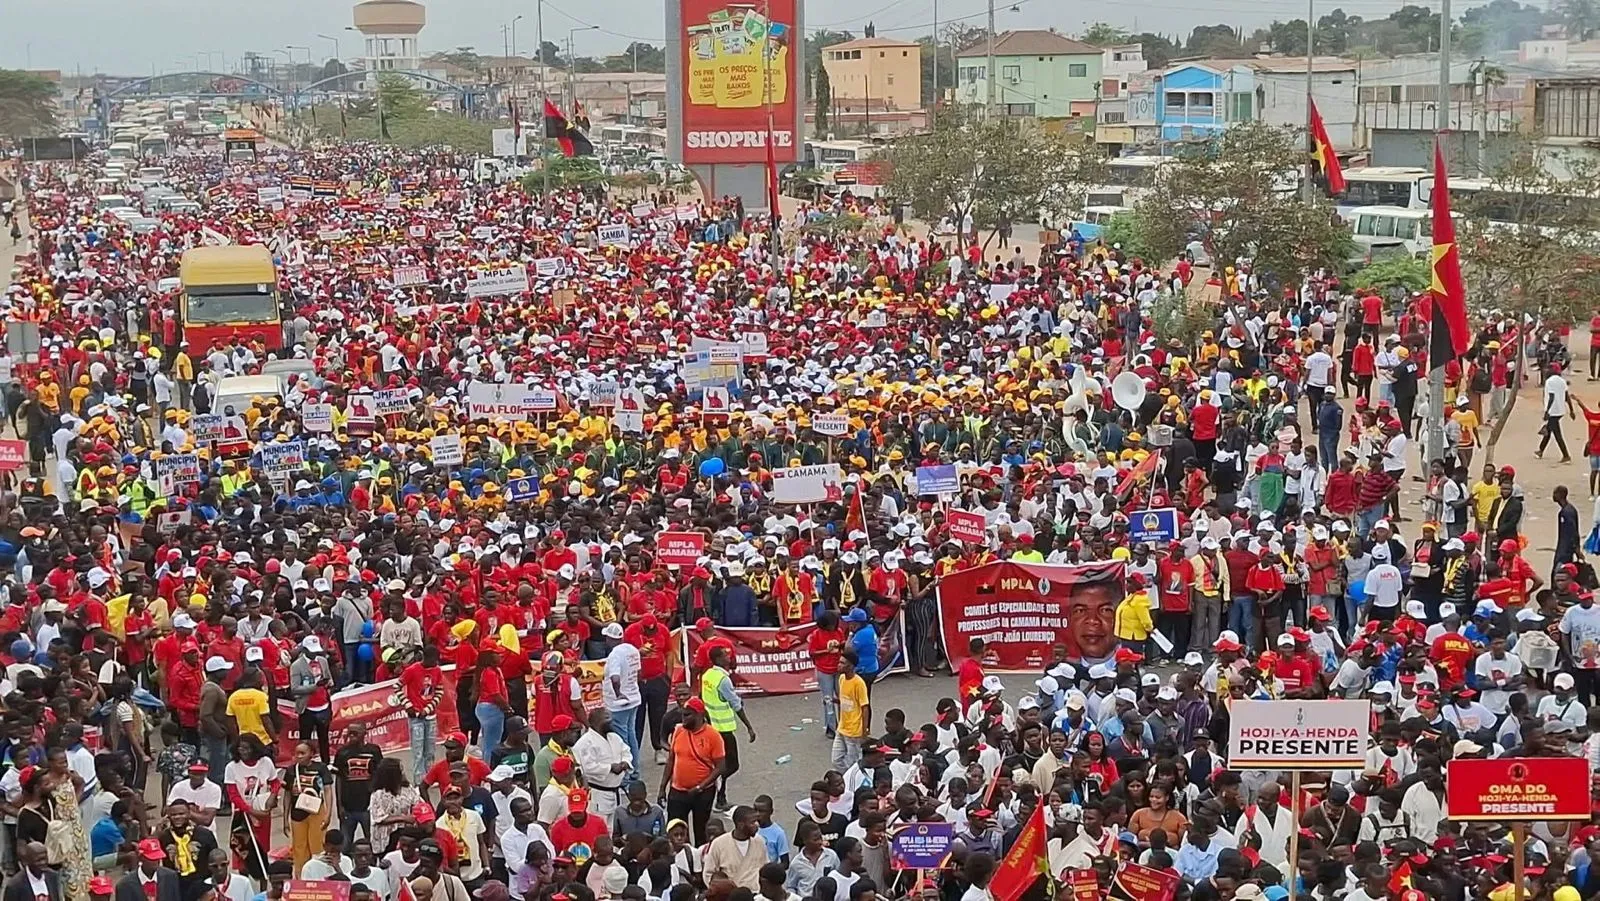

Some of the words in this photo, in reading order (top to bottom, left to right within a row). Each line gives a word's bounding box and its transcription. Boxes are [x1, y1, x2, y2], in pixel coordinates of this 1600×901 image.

[720, 66, 729, 74] OS
[731, 65, 757, 75] PREÇOS
[687, 130, 792, 148] SHOPRITE
[601, 230, 624, 240] SAMBA
[484, 269, 512, 278] MPLA
[376, 400, 408, 408] KILAMBA
[472, 404, 495, 414] VILA
[498, 404, 523, 414] FLOR
[814, 422, 846, 430] PRESENTE
[787, 466, 828, 478] CAMAMA
[957, 518, 978, 528] MPLA
[950, 524, 984, 537] CAMAMA
[1001, 578, 1034, 590] MPLA
[964, 603, 989, 616] COMITÉ
[990, 604, 998, 613] DE
[999, 602, 1045, 613] ESPECIALIDADE
[1046, 604, 1060, 614] DOS
[1010, 617, 1040, 627] CAMAMA
[1041, 618, 1061, 628] APOIA
[1062, 618, 1068, 628] O
[1004, 630, 1020, 642] JOÃO
[1022, 631, 1055, 644] LOURENÇO
[1445, 640, 1469, 650] MPLA
[735, 654, 750, 664] MA
[752, 653, 759, 663] É
[768, 652, 798, 662] FORÇA
[781, 663, 793, 672] DE
[340, 700, 383, 718] MPLA
[1240, 728, 1358, 738] HOJI-YA-HENDA
[1240, 740, 1358, 754] PRESENTE
[1489, 784, 1522, 794] OMA
[1525, 784, 1547, 794] DO
[1482, 803, 1555, 813] PRESENTE
